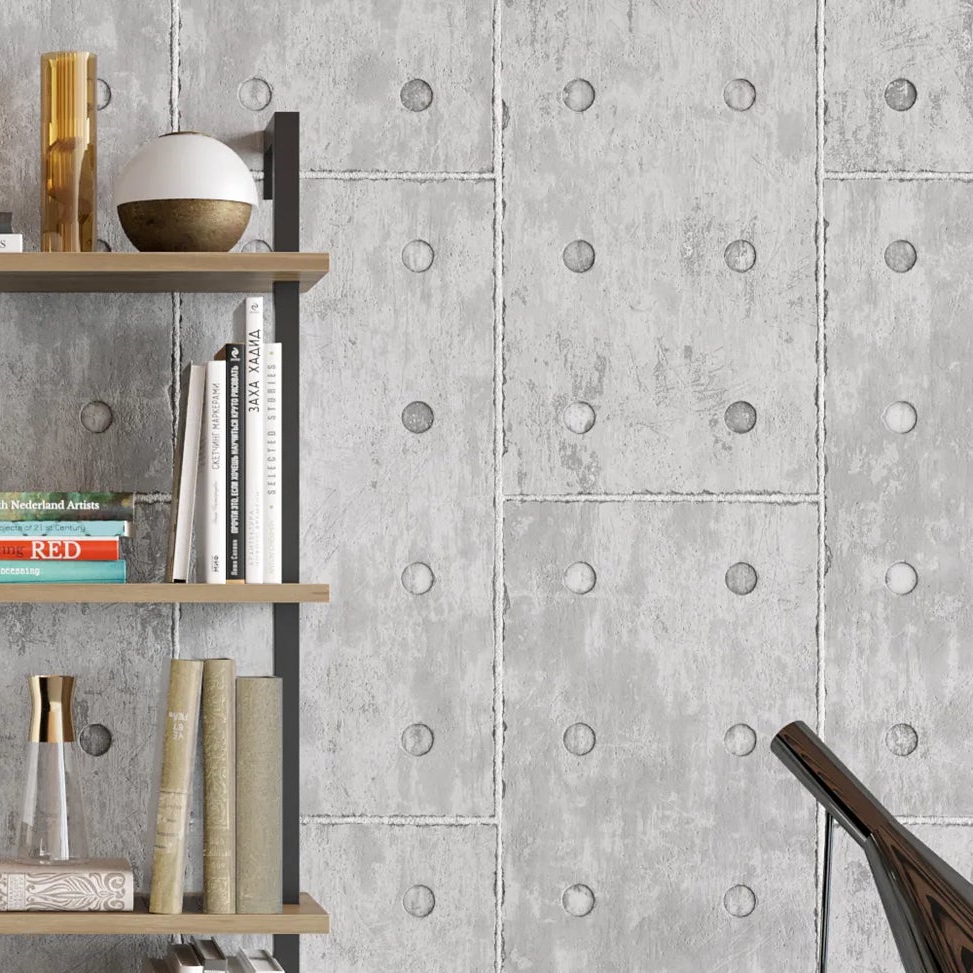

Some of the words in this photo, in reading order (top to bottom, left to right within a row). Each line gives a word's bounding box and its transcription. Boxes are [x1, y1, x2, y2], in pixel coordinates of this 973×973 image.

[249, 329, 261, 374] ХАДИД
[211, 382, 220, 430] МАРКЕРАМИ
[249, 381, 260, 412] ЗАХА
[267, 363, 276, 421] STORIES
[212, 432, 220, 470] СКЕТЧИНГ
[267, 429, 276, 496] SELECTED
[11, 499, 65, 510] Nederland
[66, 499, 100, 510] Artists
[54, 524, 86, 534] Century
[30, 540, 82, 559] RED
